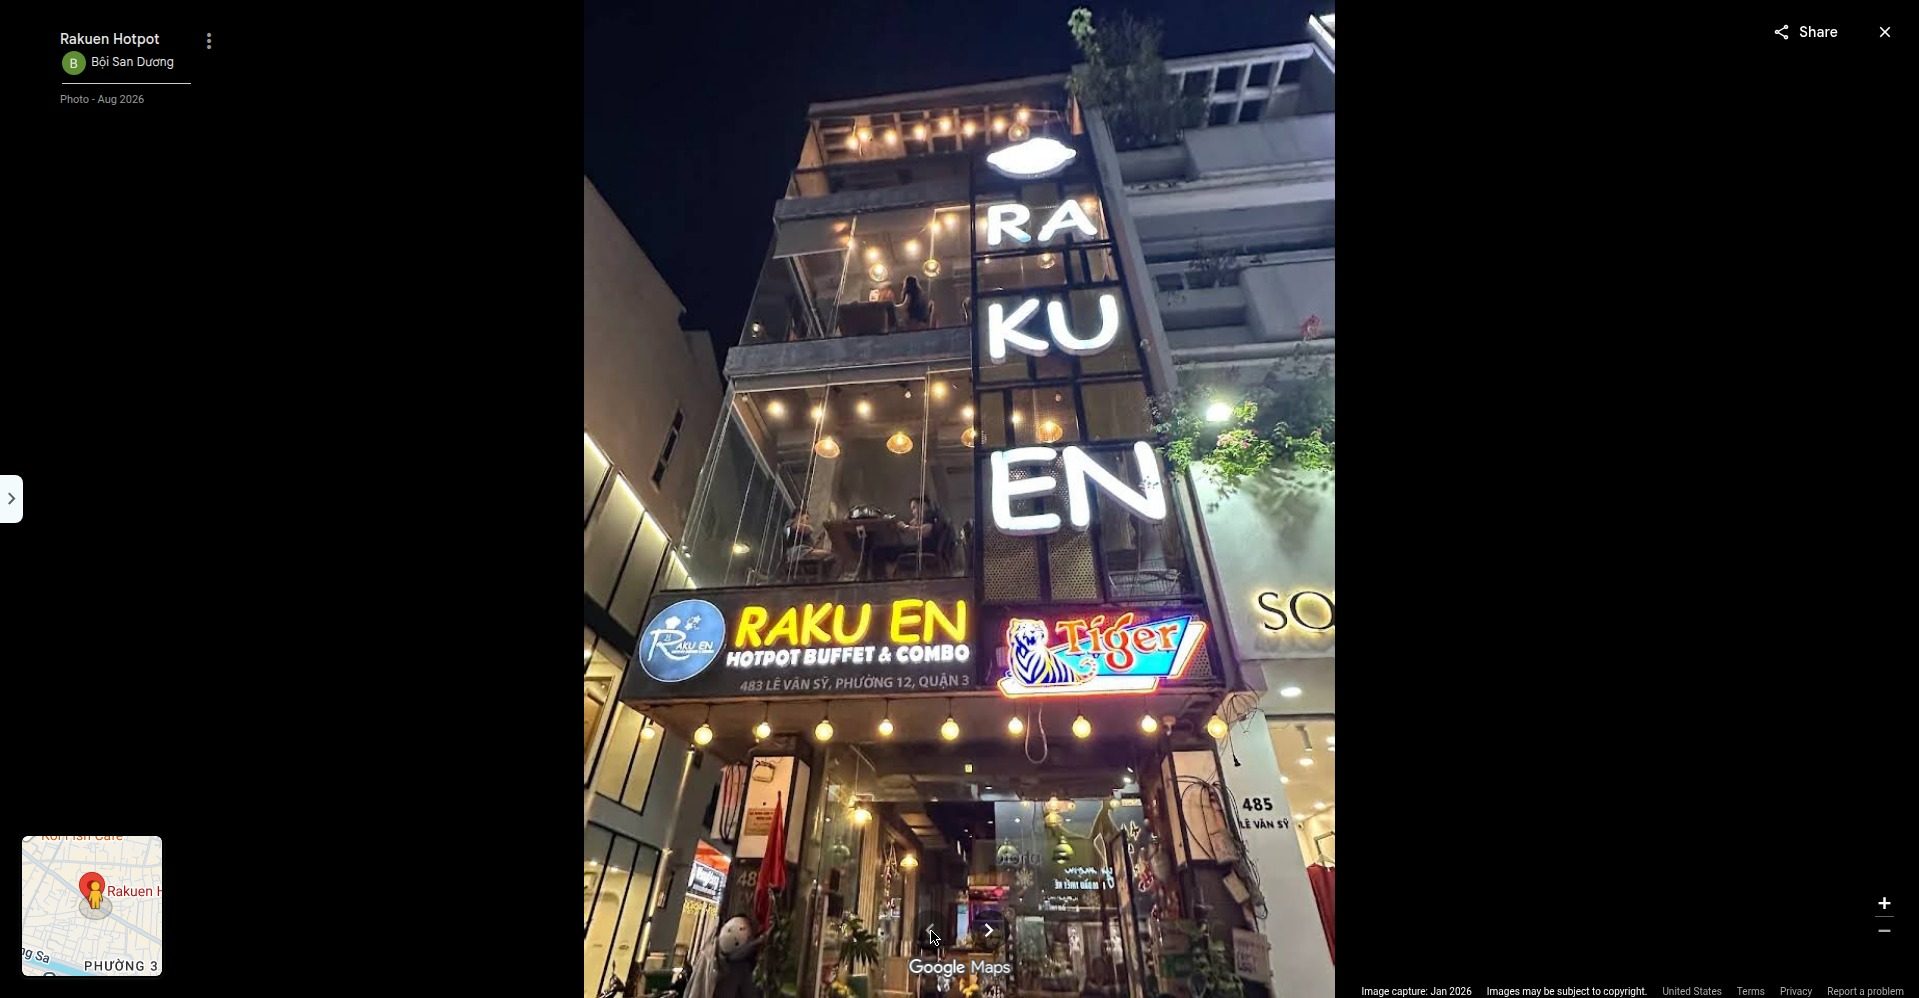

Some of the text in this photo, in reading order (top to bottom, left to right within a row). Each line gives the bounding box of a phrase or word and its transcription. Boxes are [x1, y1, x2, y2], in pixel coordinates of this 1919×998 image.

[987, 199, 1098, 246] RA
[988, 294, 1119, 358] KU
[990, 441, 1167, 534] EN
[735, 598, 968, 647] RAKU EN
[1258, 591, 1335, 630] SO
[726, 643, 970, 668] HOTPOT BUFFET & COMBO
[1055, 611, 1178, 672] Tiger
[740, 680, 763, 692] 483
[766, 676, 781, 691] LÊ
[835, 673, 894, 689] PHƯỜNG
[897, 676, 915, 689] 12,
[918, 672, 959, 689] QUẬN
[961, 674, 970, 686] 3
[1243, 797, 1273, 811] 485
[737, 870, 757, 887] 48
